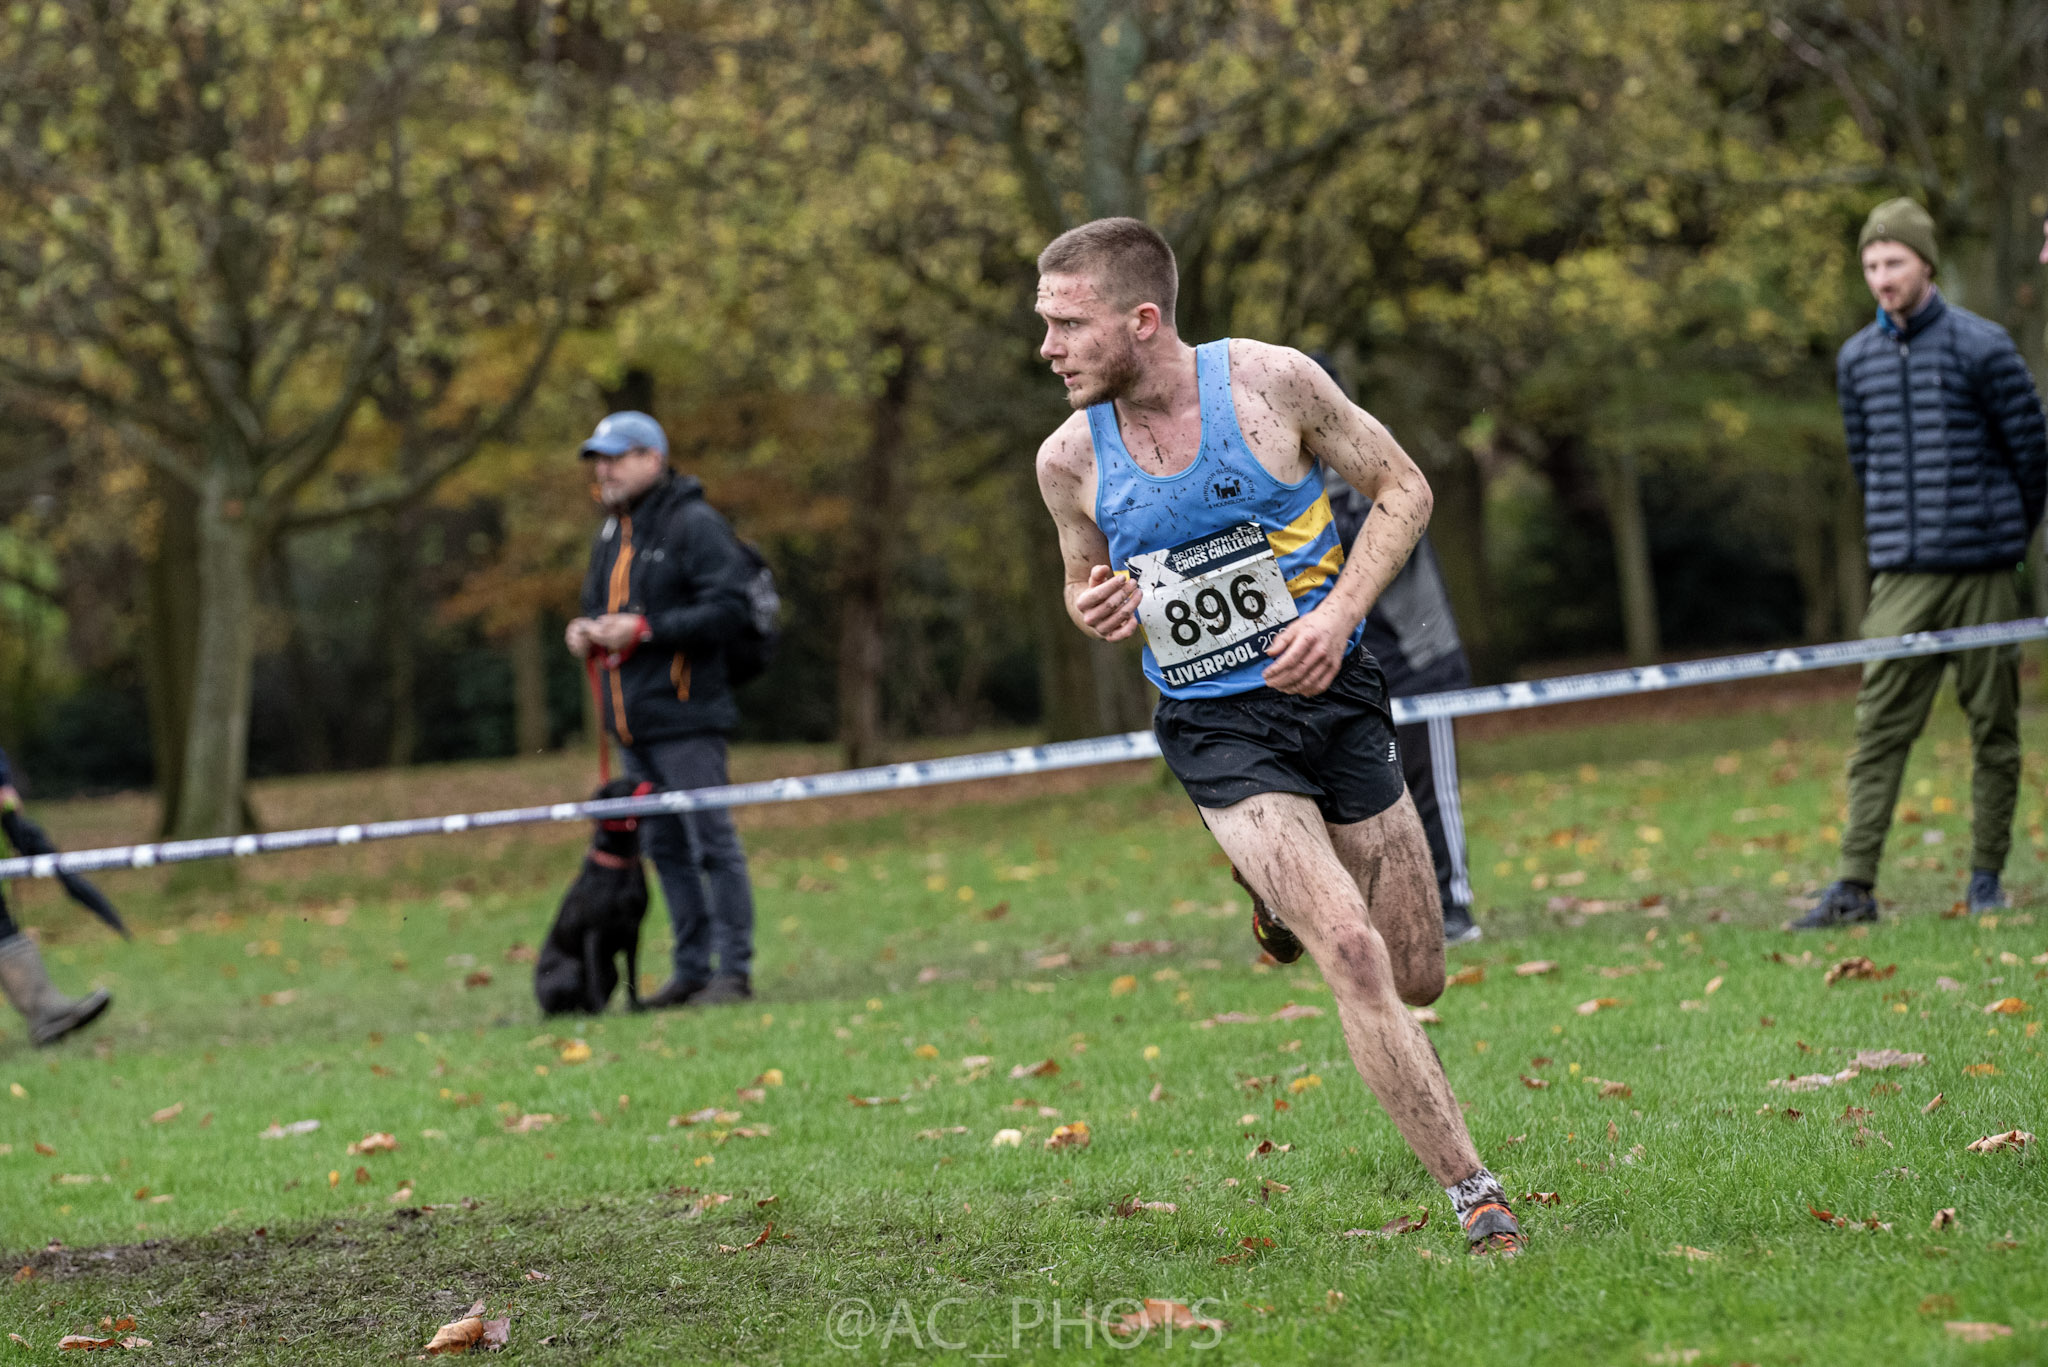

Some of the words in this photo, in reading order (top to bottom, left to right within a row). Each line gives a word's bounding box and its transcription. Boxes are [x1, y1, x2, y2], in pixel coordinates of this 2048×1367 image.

[1175, 551, 1208, 572] CROSS
[1207, 531, 1265, 559] CHALLENGE
[1165, 574, 1266, 647] 896
[1166, 642, 1260, 685] LIVERPOOL
[1258, 628, 1286, 652] 20
